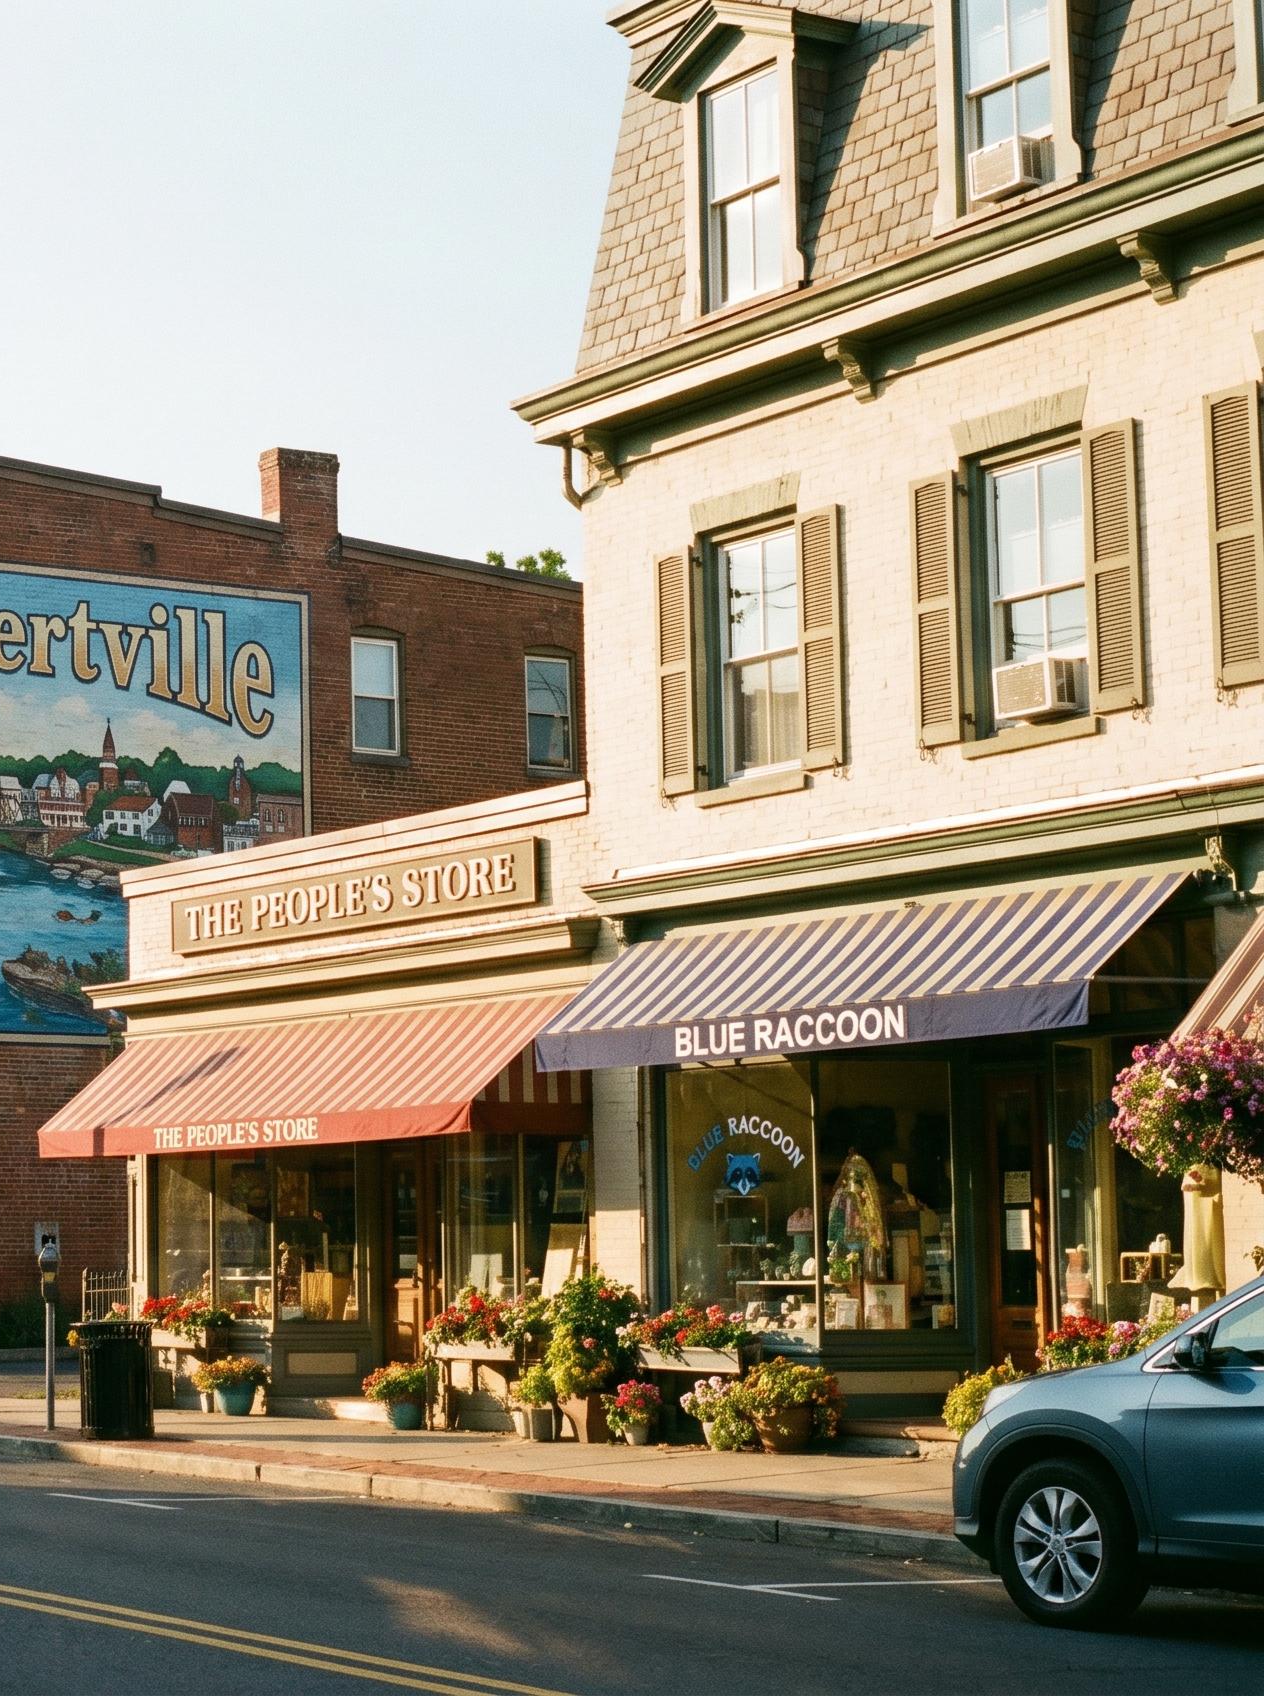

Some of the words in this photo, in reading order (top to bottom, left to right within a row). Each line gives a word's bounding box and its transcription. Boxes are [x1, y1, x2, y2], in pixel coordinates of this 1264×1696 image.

[185, 899, 242, 941] THE
[251, 873, 393, 931] PEOPLE'S
[401, 853, 516, 908] STORE
[674, 1021, 746, 1058] BLUE
[754, 1005, 905, 1051] RACCOON
[153, 1126, 184, 1149] THE
[187, 1121, 259, 1147] PEOPLE'S
[263, 1117, 319, 1143] STORE
[687, 1124, 725, 1172] BLUE
[728, 1115, 805, 1169] RACCOON
